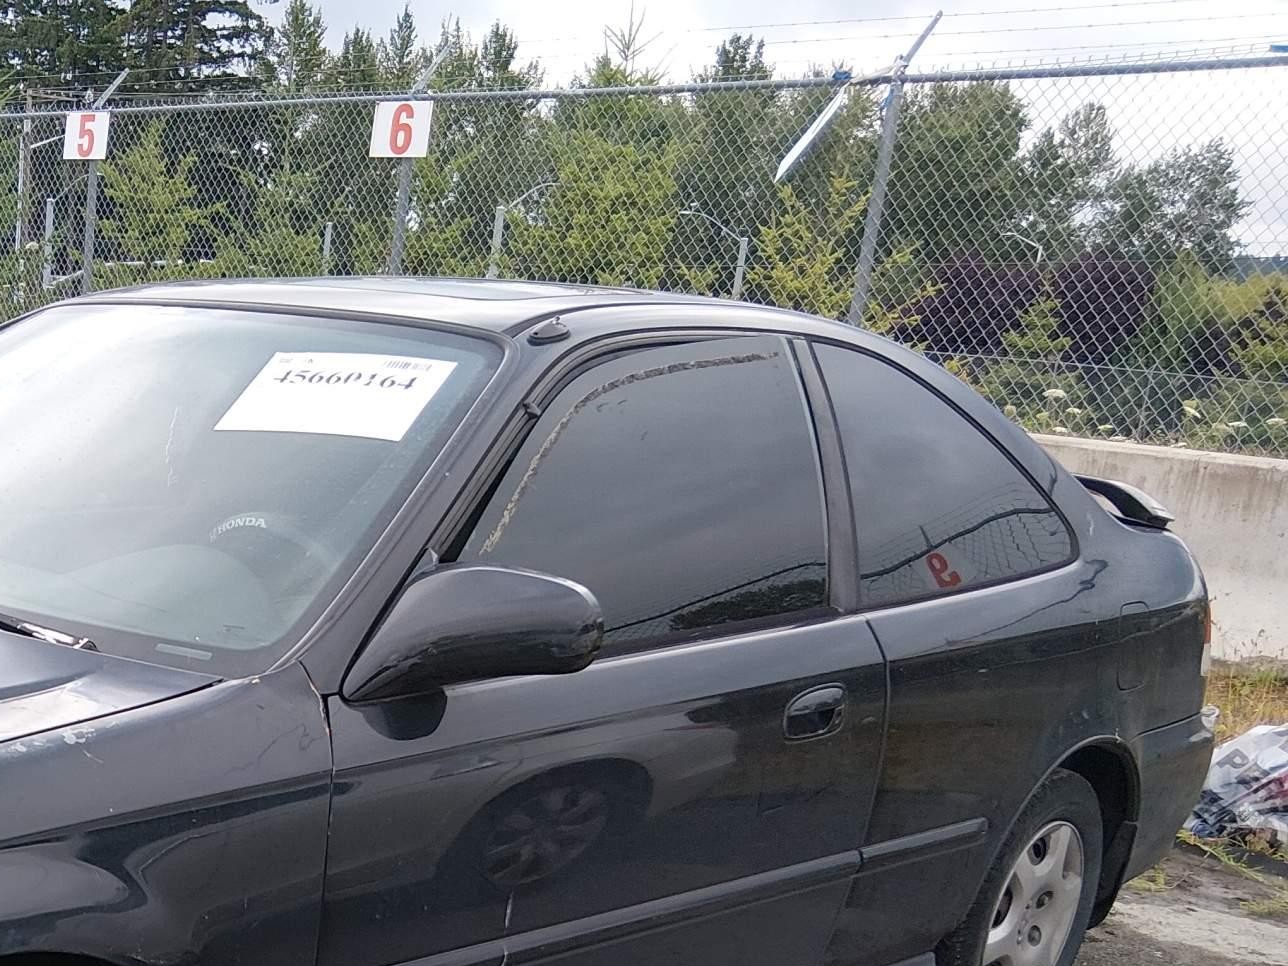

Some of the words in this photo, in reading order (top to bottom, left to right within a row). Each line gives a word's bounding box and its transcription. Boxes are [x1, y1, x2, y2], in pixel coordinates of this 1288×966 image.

[77, 114, 95, 158] 5
[389, 103, 414, 155] 6
[217, 517, 267, 535] HONDA
